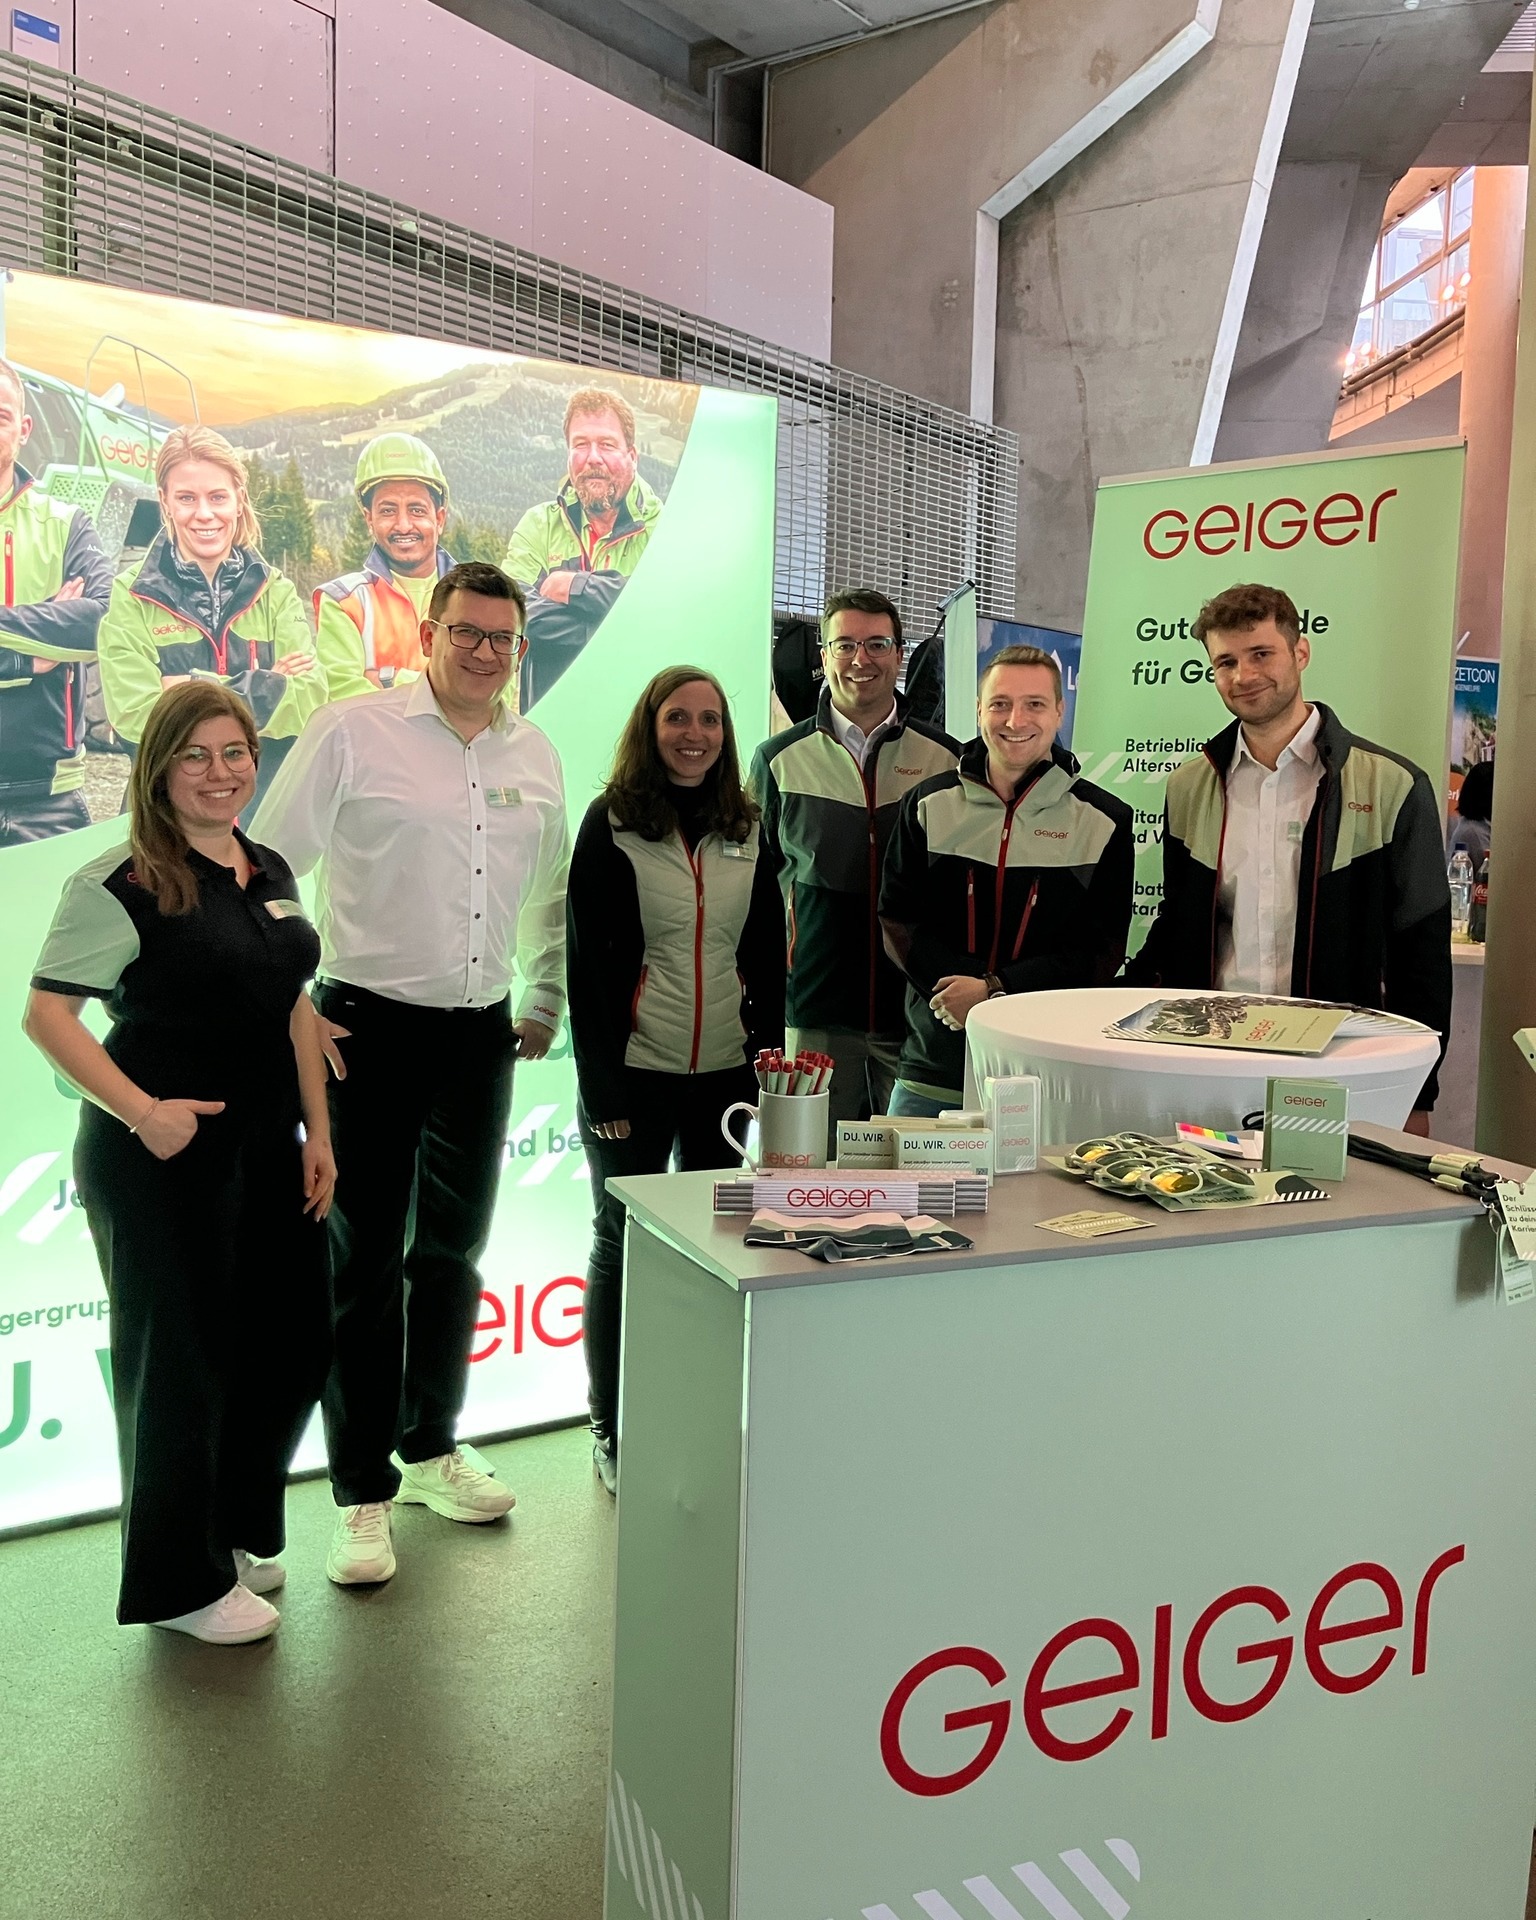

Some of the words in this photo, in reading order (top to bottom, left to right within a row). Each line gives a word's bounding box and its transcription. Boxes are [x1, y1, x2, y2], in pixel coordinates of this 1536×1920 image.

[1067, 665, 1081, 691] L
[1131, 660, 1172, 686] für
[1454, 666, 1495, 684] ZETCON
[843, 1132, 861, 1143] DU.
[862, 1133, 886, 1143] WIR.
[903, 1140, 921, 1150] DU.
[923, 1140, 946, 1150] WIR.
[1502, 1194, 1517, 1202] Der
[1505, 1204, 1536, 1213] Schlüss
